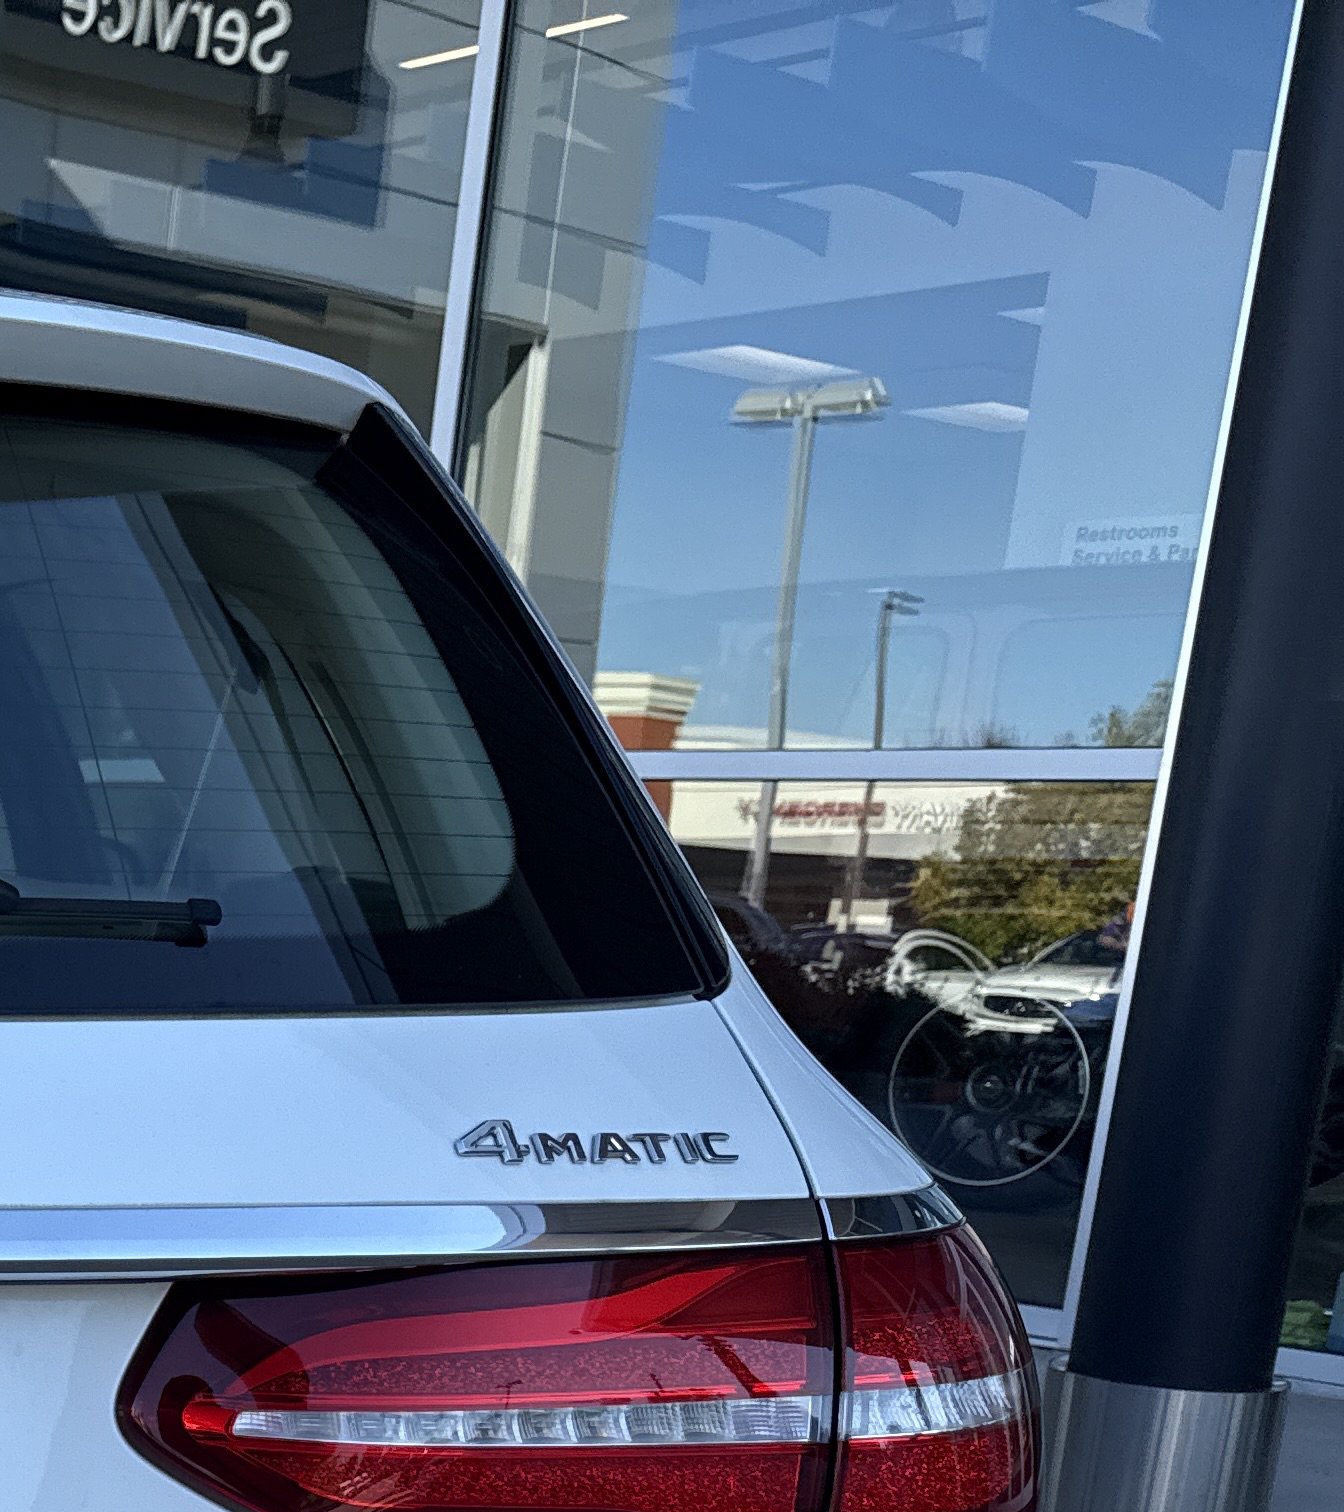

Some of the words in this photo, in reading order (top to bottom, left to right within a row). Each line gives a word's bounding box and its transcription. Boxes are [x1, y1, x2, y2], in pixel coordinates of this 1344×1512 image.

[1075, 525, 1179, 543] Restrooms
[1071, 547, 1144, 566] Service
[453, 1118, 739, 1165] 4MATIC
